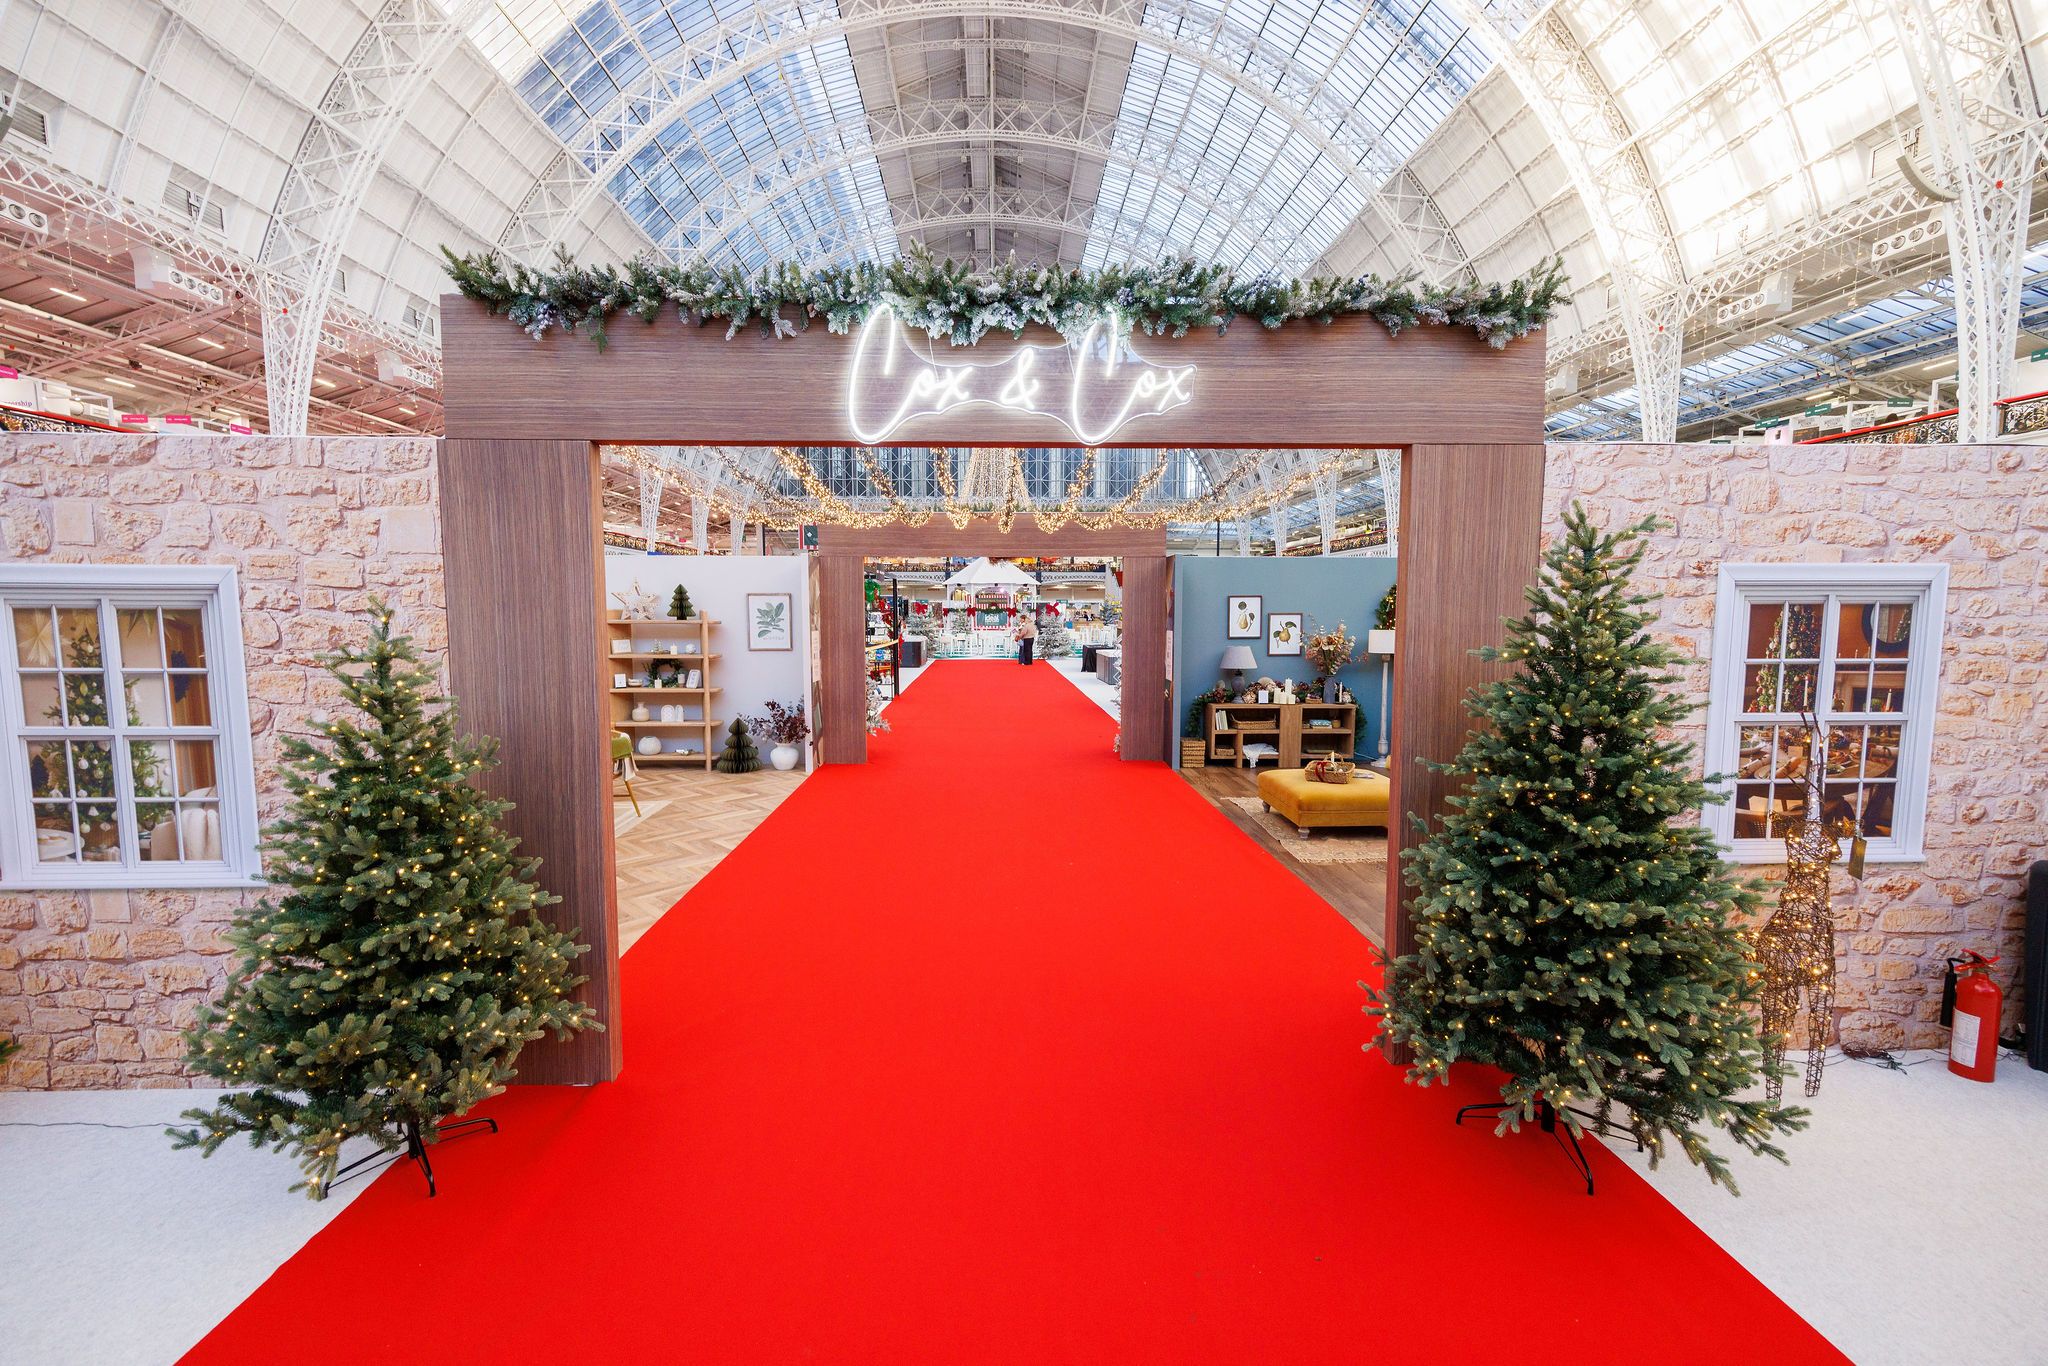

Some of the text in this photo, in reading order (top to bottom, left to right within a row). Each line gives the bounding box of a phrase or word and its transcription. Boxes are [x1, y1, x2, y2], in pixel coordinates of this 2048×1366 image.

[849, 303, 1196, 445] Cox & Cox
